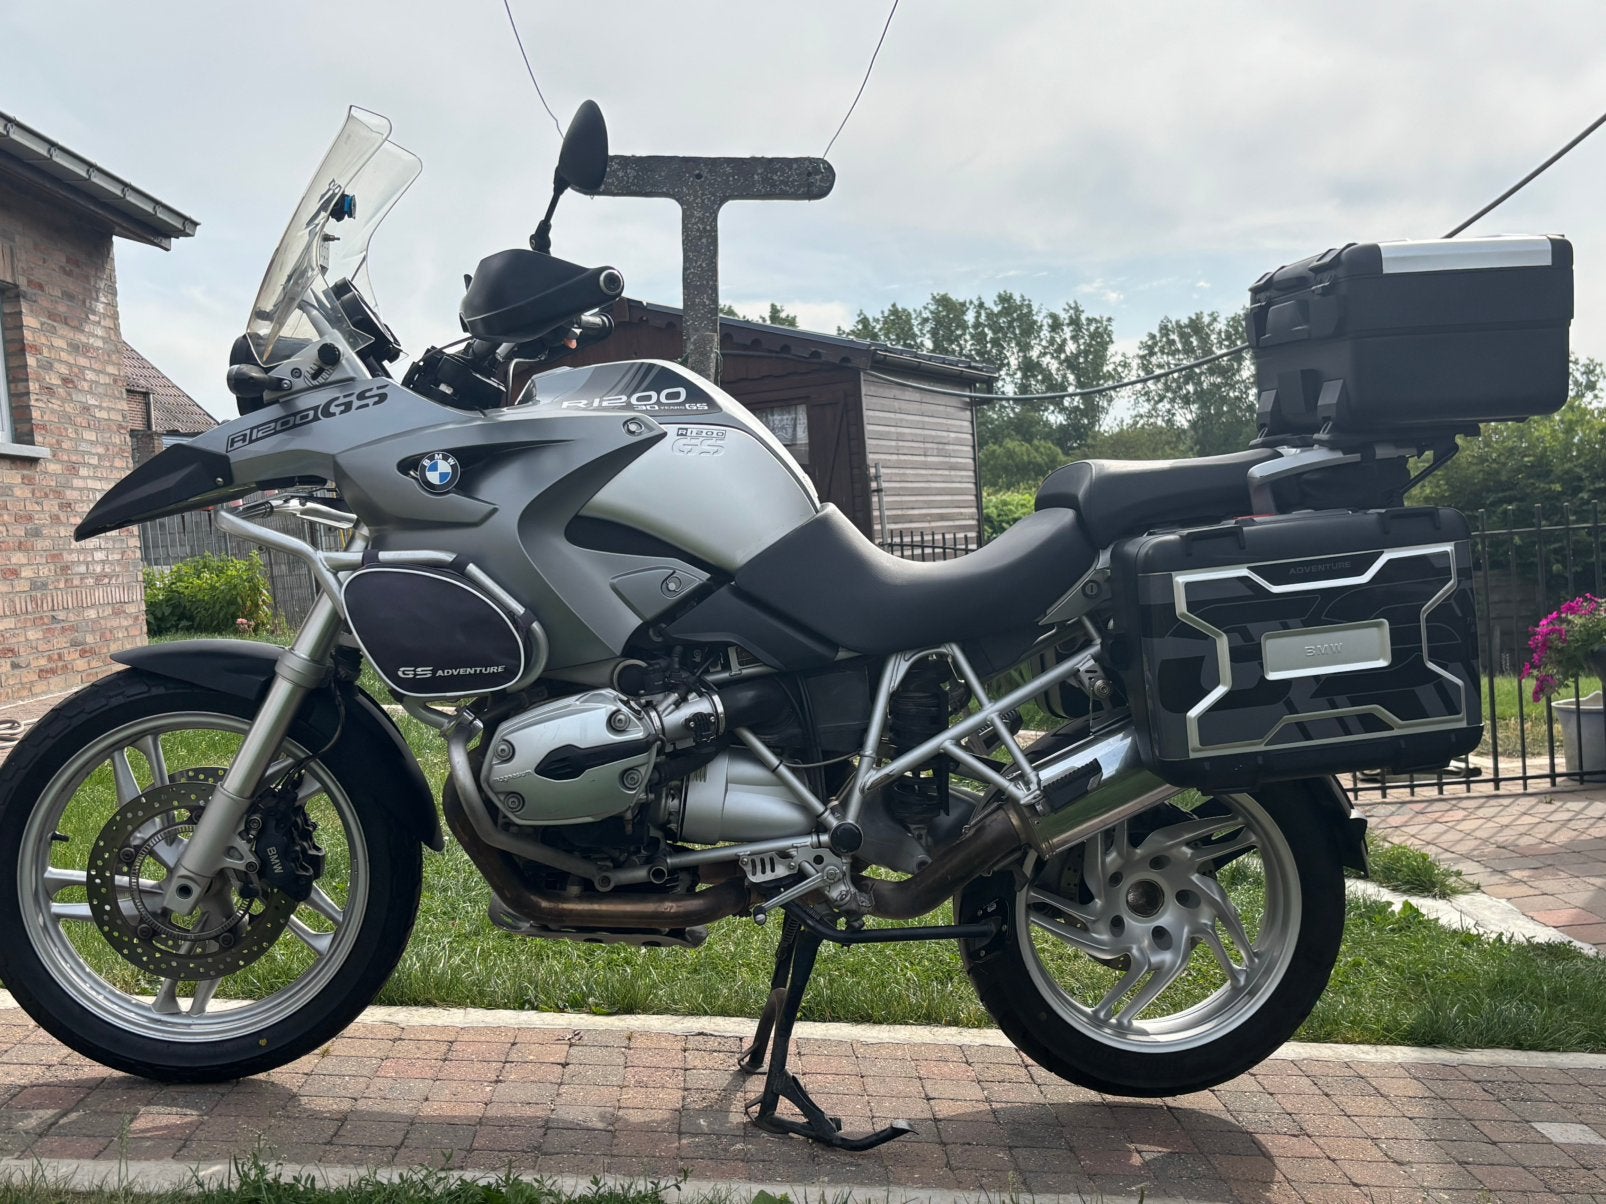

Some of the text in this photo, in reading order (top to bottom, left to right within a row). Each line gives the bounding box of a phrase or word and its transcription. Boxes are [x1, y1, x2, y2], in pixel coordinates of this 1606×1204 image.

[561, 387, 687, 409] R1200
[685, 402, 708, 410] GS
[678, 428, 726, 438] R1200
[672, 437, 726, 456] GS
[422, 453, 456, 467] BMW
[1289, 561, 1352, 575] ADVENTURE
[1305, 642, 1344, 657] BMW
[398, 665, 505, 678] GS ADVENTURE
[267, 846, 284, 873] BMW
